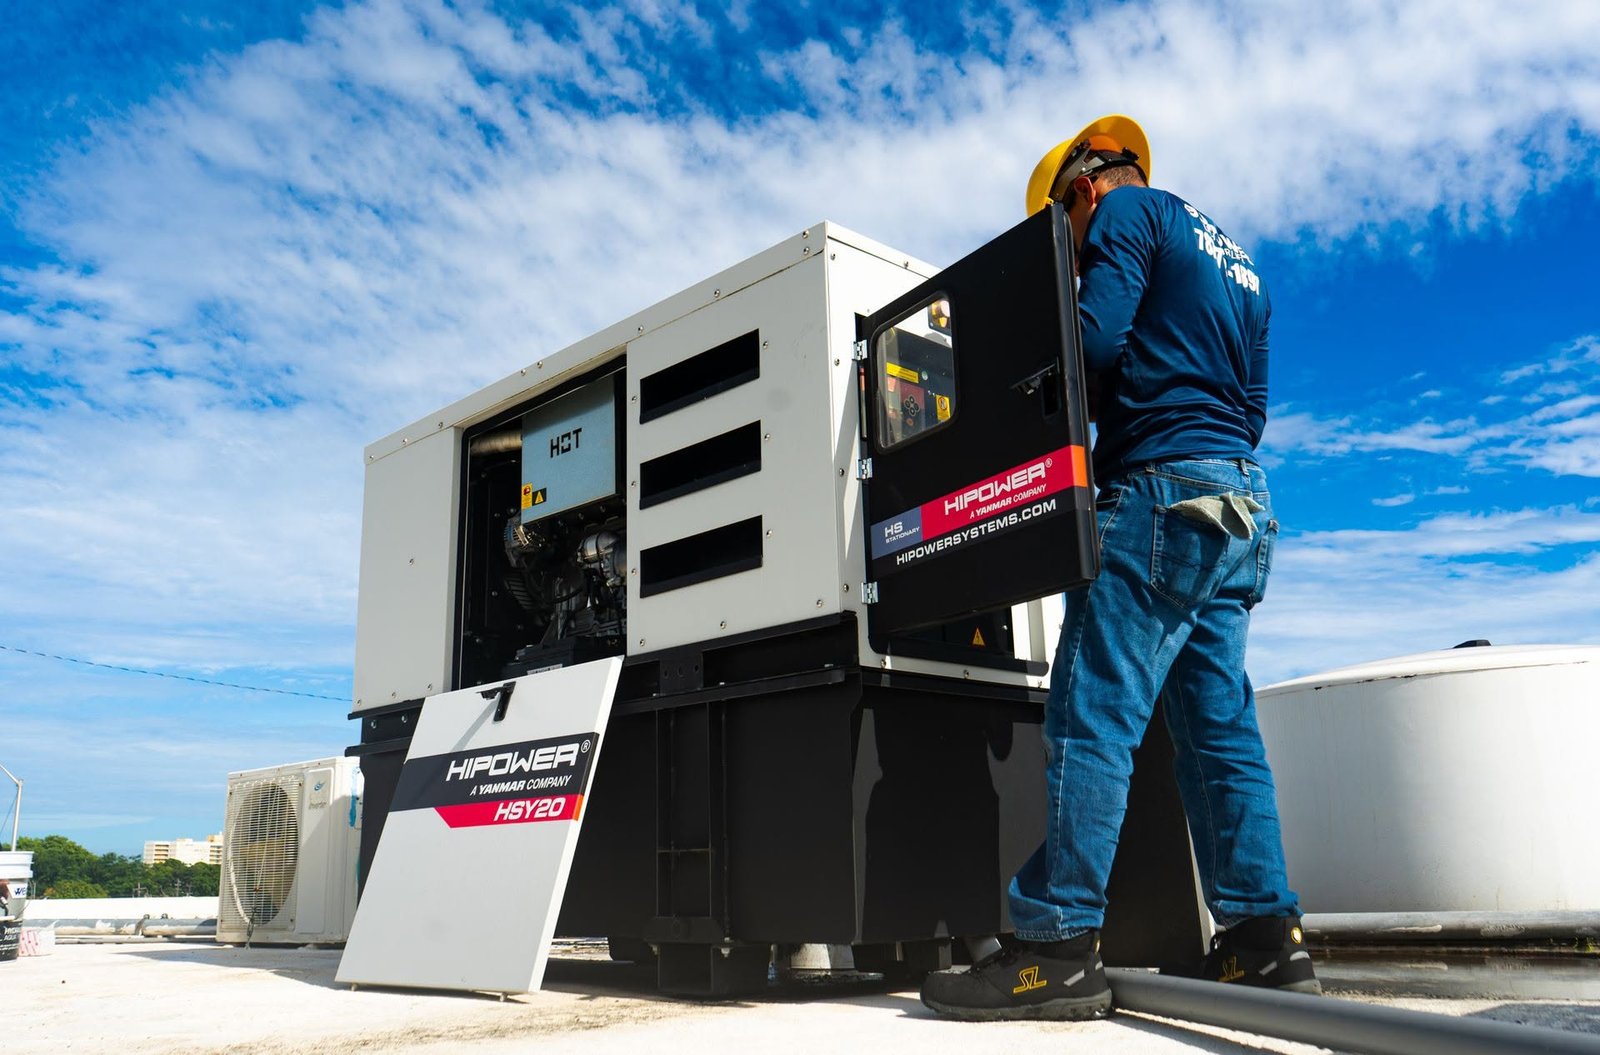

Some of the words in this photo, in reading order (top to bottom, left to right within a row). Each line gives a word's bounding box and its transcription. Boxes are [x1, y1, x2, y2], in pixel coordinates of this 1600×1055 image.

[550, 428, 582, 458] HOT
[969, 511, 976, 519] A
[976, 496, 1012, 517] YANMAR
[1013, 483, 1047, 502] COMPANY
[884, 521, 904, 537] HS
[885, 526, 920, 544] STATIONARY
[896, 498, 1057, 566] HIPOWERSYSTEMS.COM
[470, 785, 477, 796] A
[478, 780, 526, 795] YANMAR
[526, 775, 572, 790] COMPANY
[494, 797, 566, 822] HSY20
